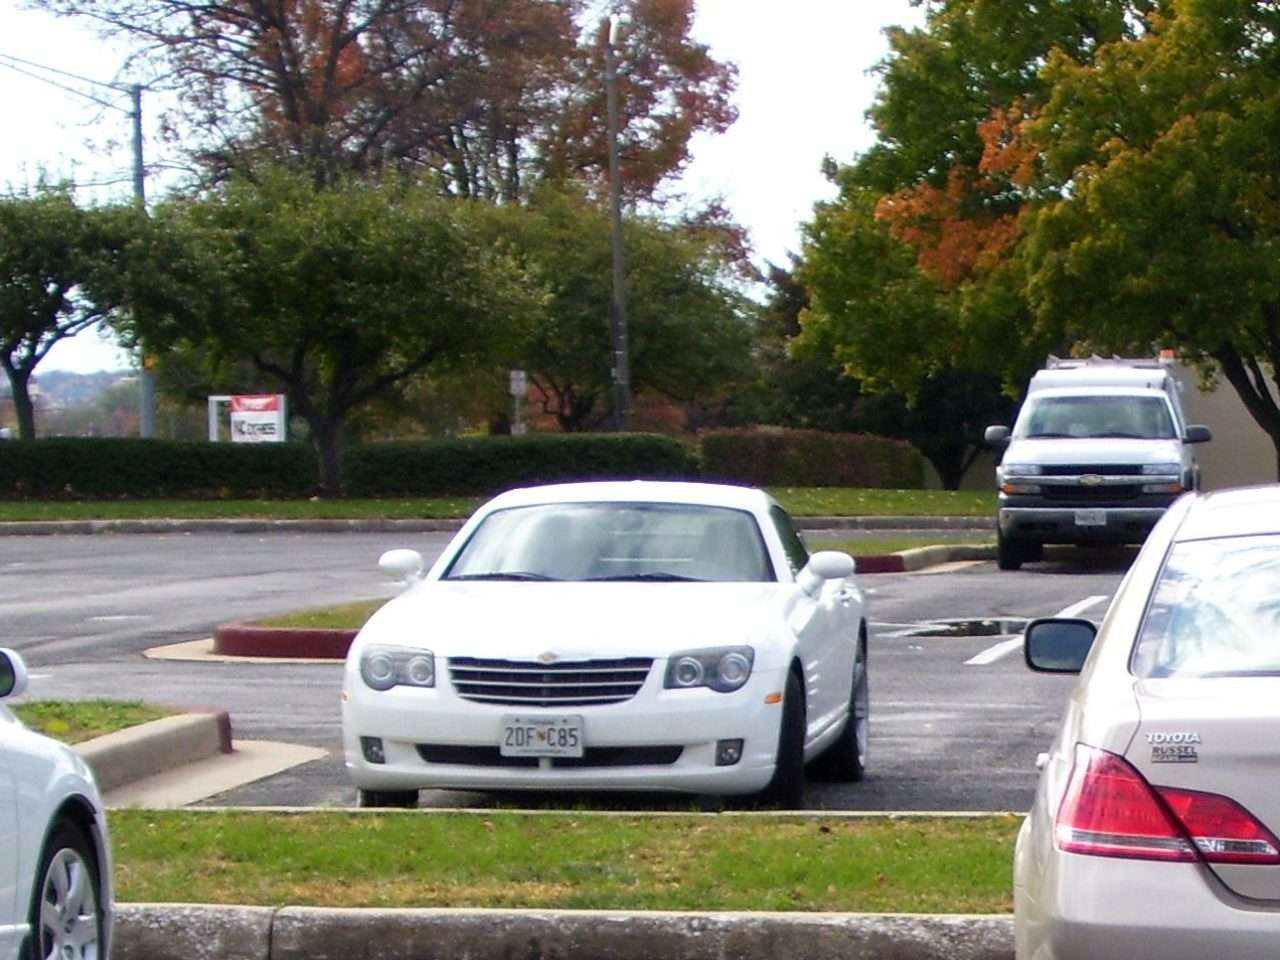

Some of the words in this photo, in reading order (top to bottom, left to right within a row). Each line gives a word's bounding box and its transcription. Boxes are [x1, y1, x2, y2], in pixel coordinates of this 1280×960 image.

[547, 728, 578, 747] C85
[1145, 732, 1201, 744] TOYOTA
[1152, 746, 1197, 754] RUSSEL
